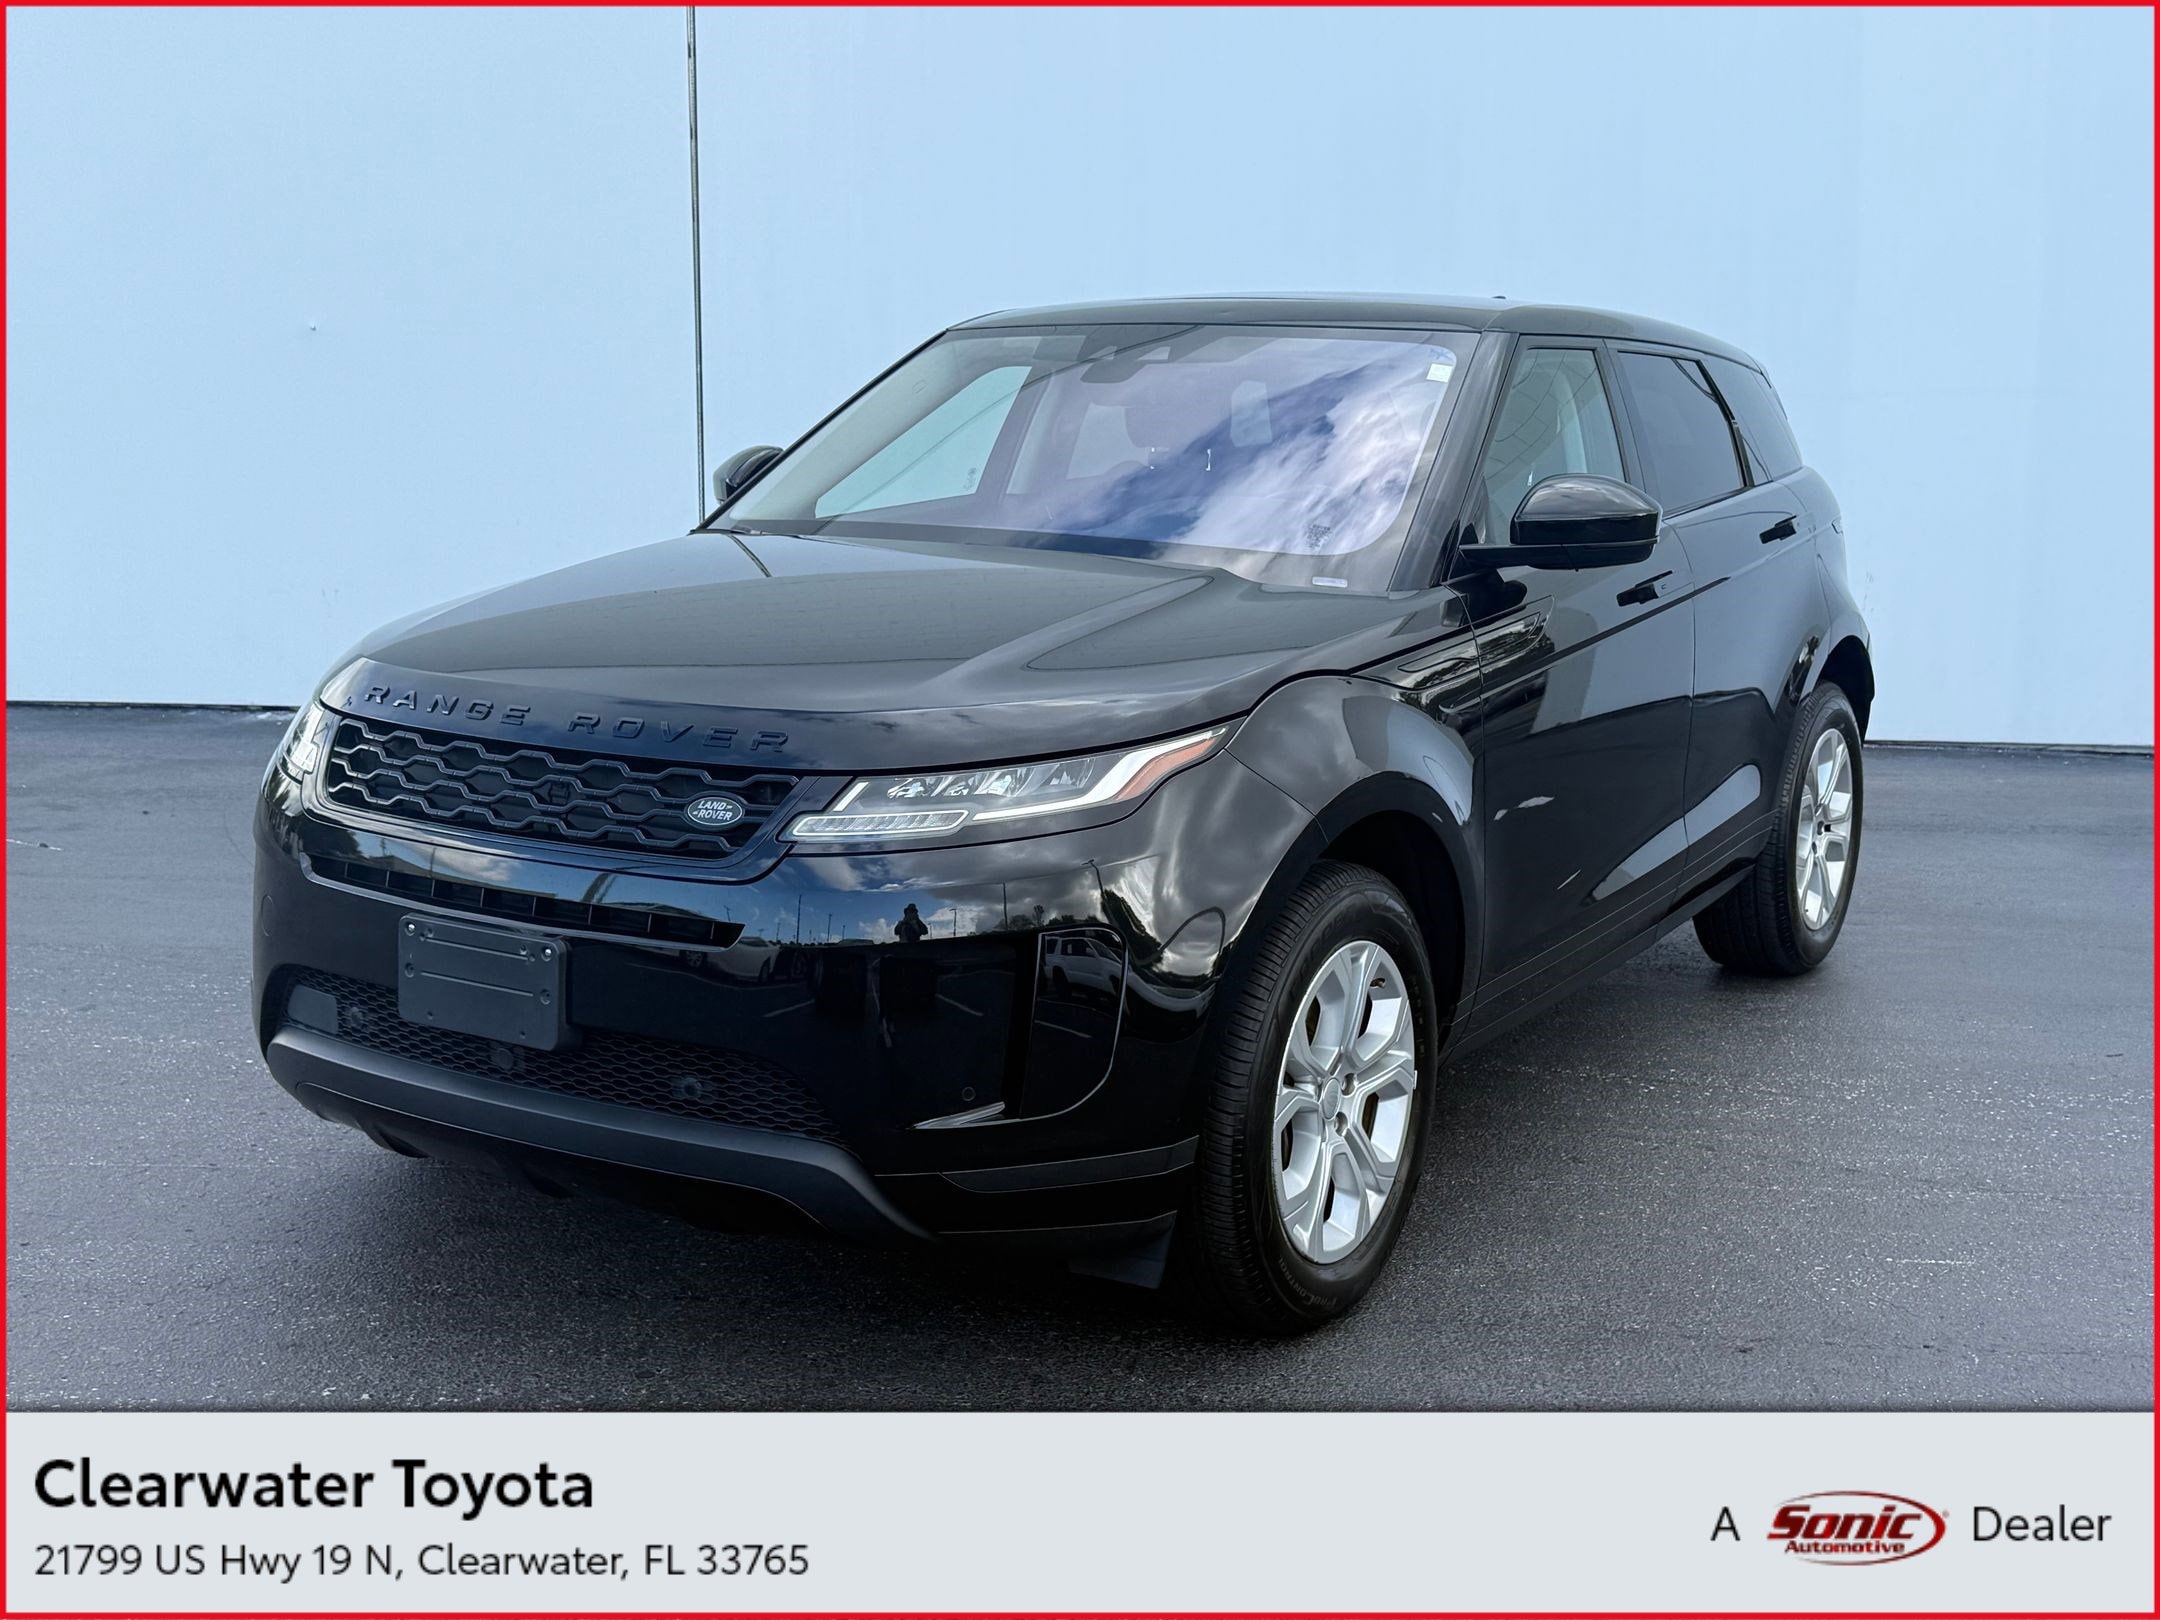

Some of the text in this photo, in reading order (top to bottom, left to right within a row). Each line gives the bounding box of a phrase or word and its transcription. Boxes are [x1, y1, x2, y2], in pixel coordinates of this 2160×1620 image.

[363, 683, 790, 753] RANGE ROVER
[697, 809, 733, 821] ROVER
